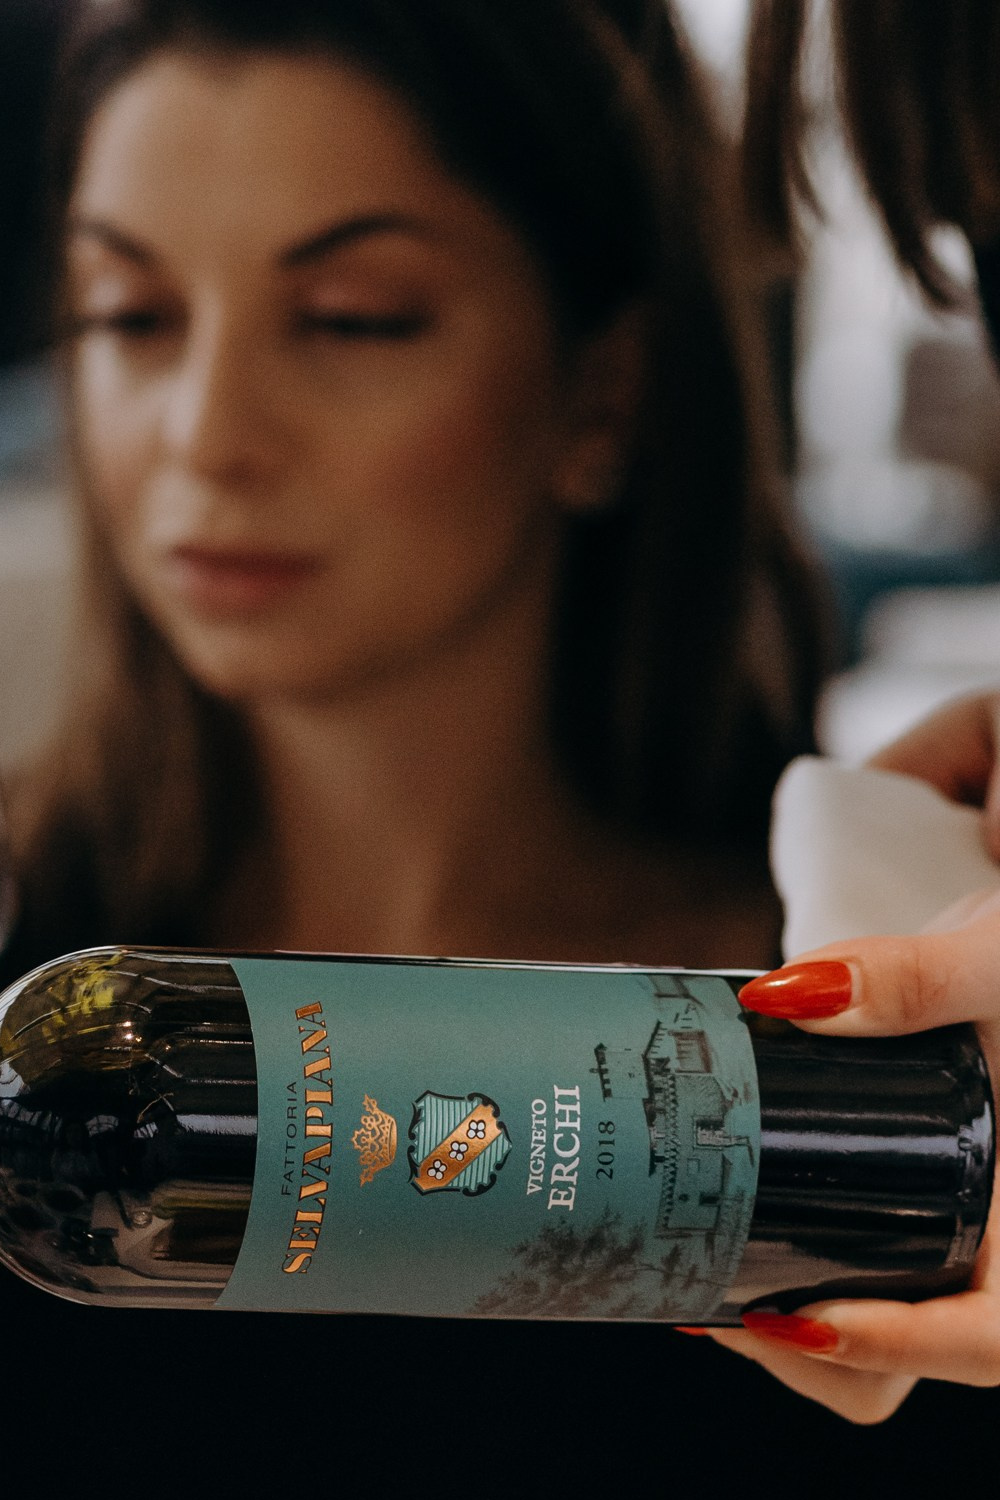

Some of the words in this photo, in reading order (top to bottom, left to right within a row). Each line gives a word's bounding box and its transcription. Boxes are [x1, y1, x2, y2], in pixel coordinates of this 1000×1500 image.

[281, 1081, 297, 1195] FATTORIA
[282, 1001, 333, 1274] SELVAPIANA
[526, 1098, 547, 1195] VIGNETO
[547, 1084, 580, 1211] ERCHI
[595, 1120, 615, 1180] 2018
